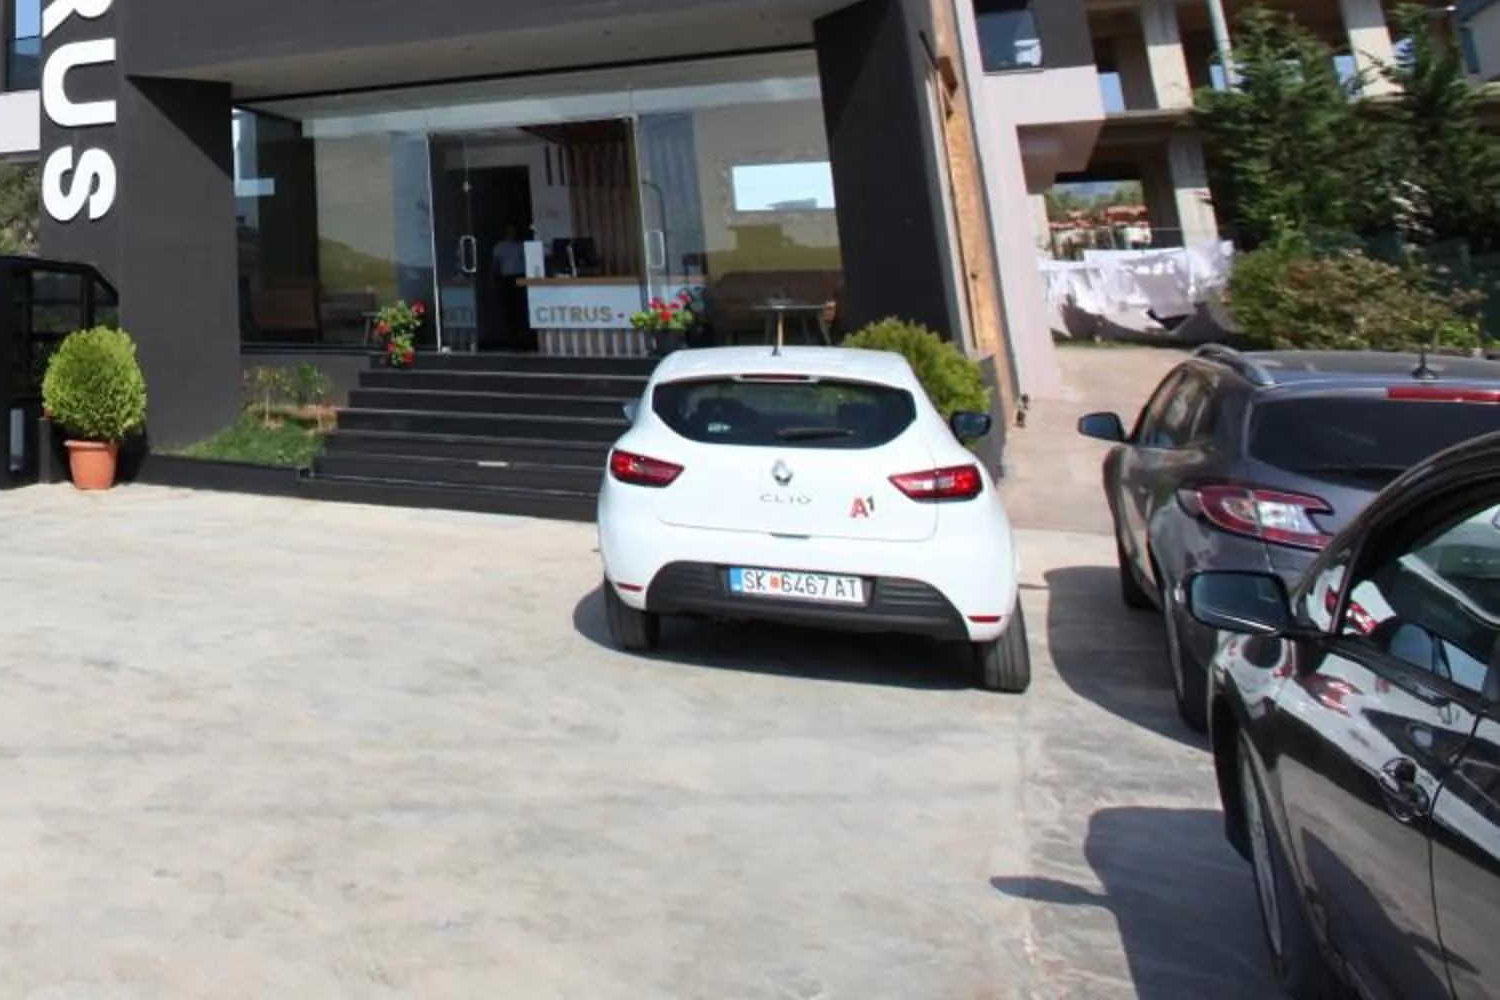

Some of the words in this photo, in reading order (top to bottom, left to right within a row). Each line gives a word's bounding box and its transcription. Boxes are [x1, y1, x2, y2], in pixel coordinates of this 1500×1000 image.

[535, 305, 613, 323] CITRUS
[759, 493, 812, 504] CLIO
[743, 570, 767, 591] SK
[781, 573, 830, 595] 6467
[835, 578, 858, 598] AT
